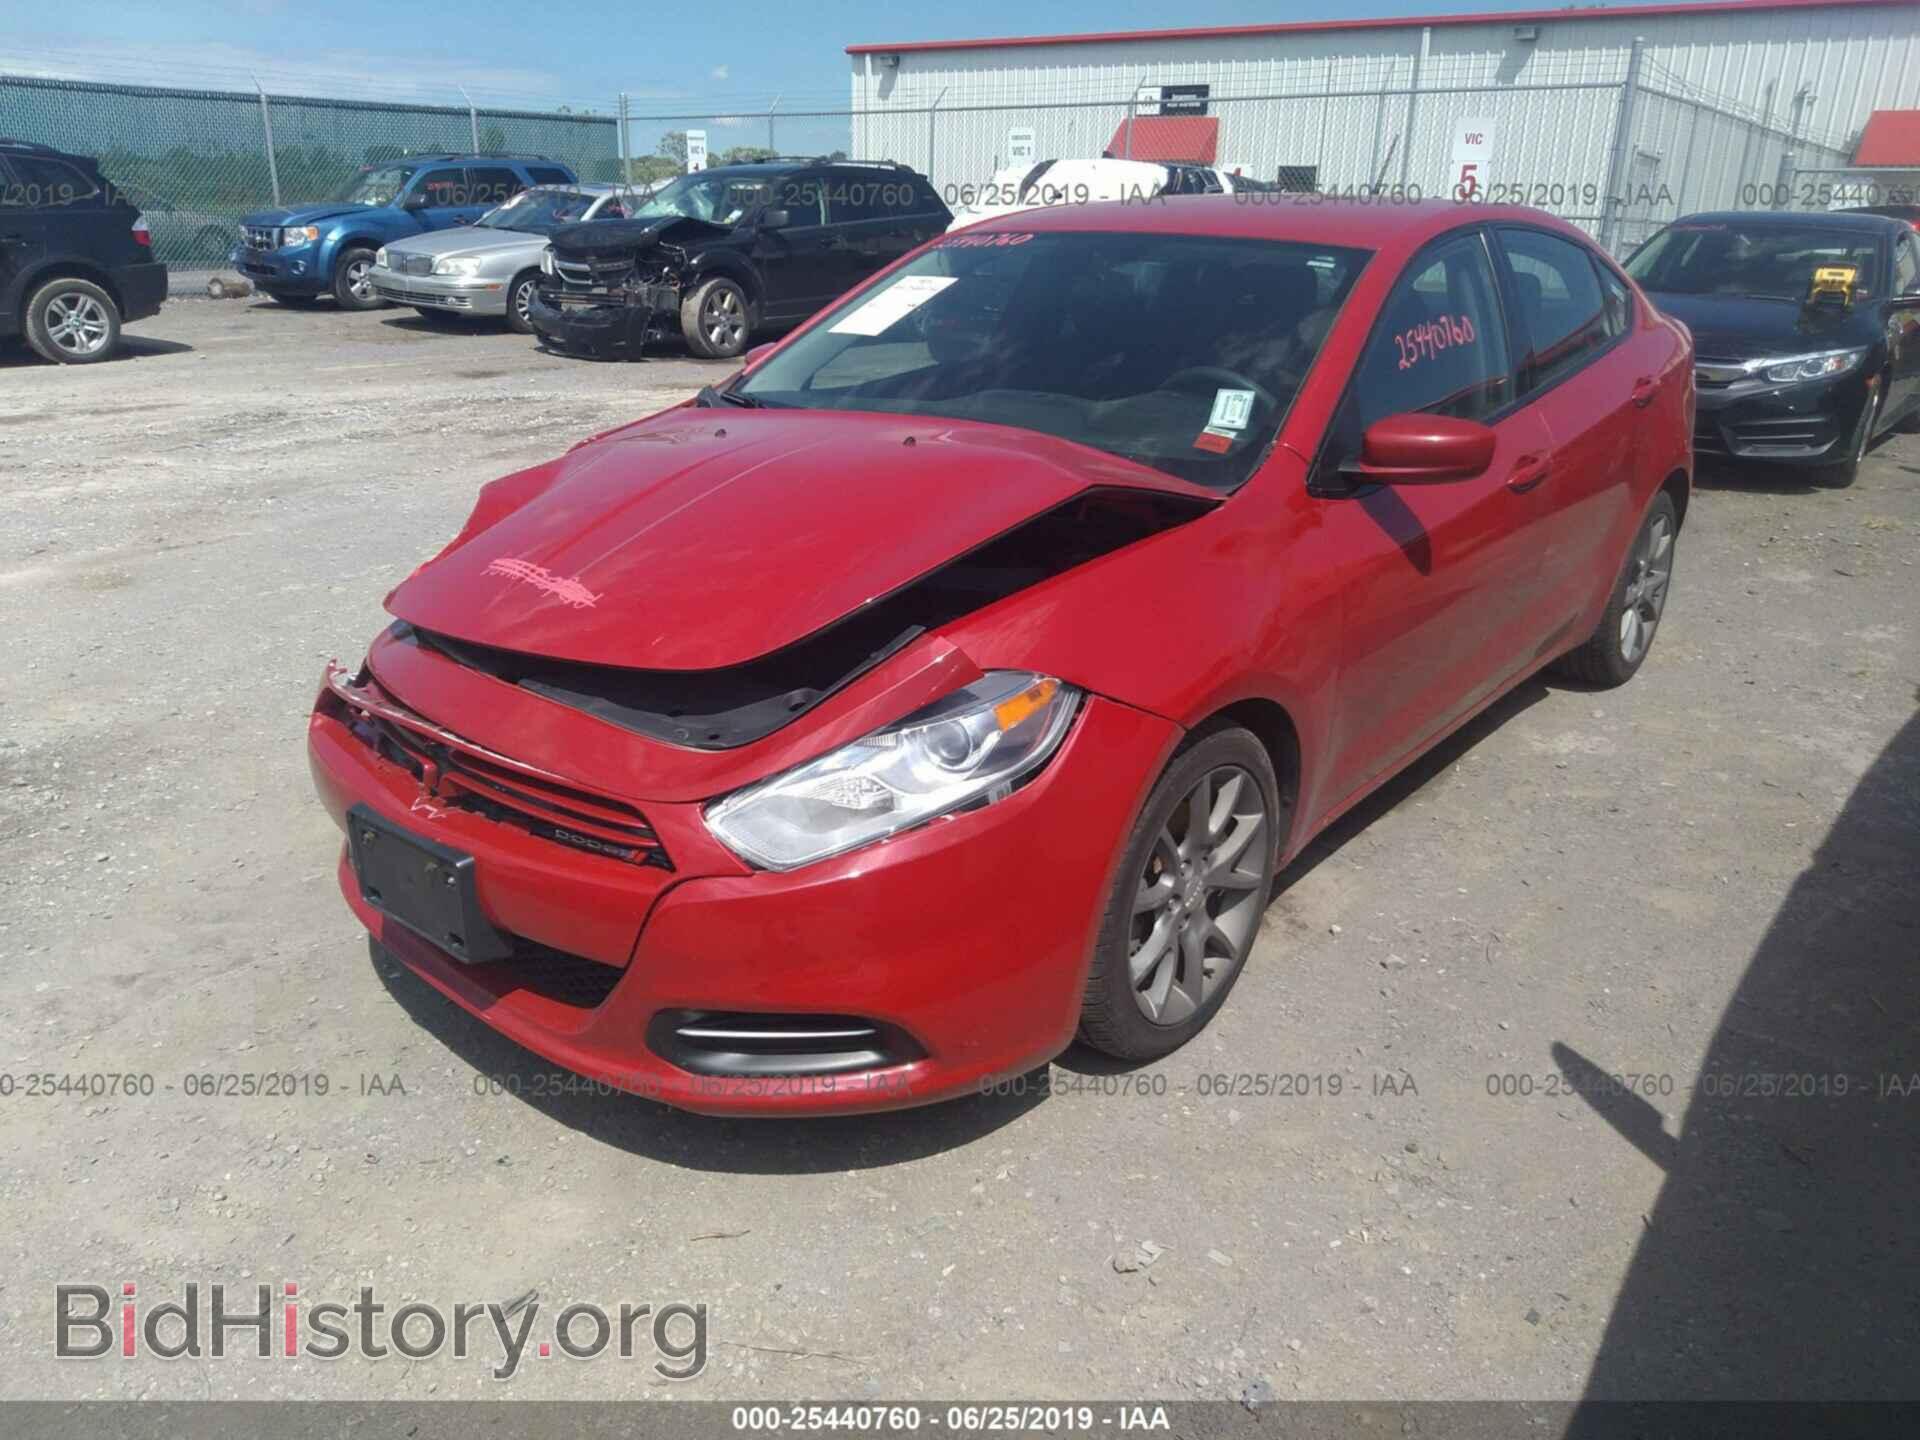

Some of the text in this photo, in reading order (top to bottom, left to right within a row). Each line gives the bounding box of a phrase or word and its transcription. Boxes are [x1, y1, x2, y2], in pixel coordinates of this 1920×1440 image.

[1465, 132, 1484, 146] VIC
[1459, 164, 1477, 199] 5
[1393, 314, 1476, 370] 25440760
